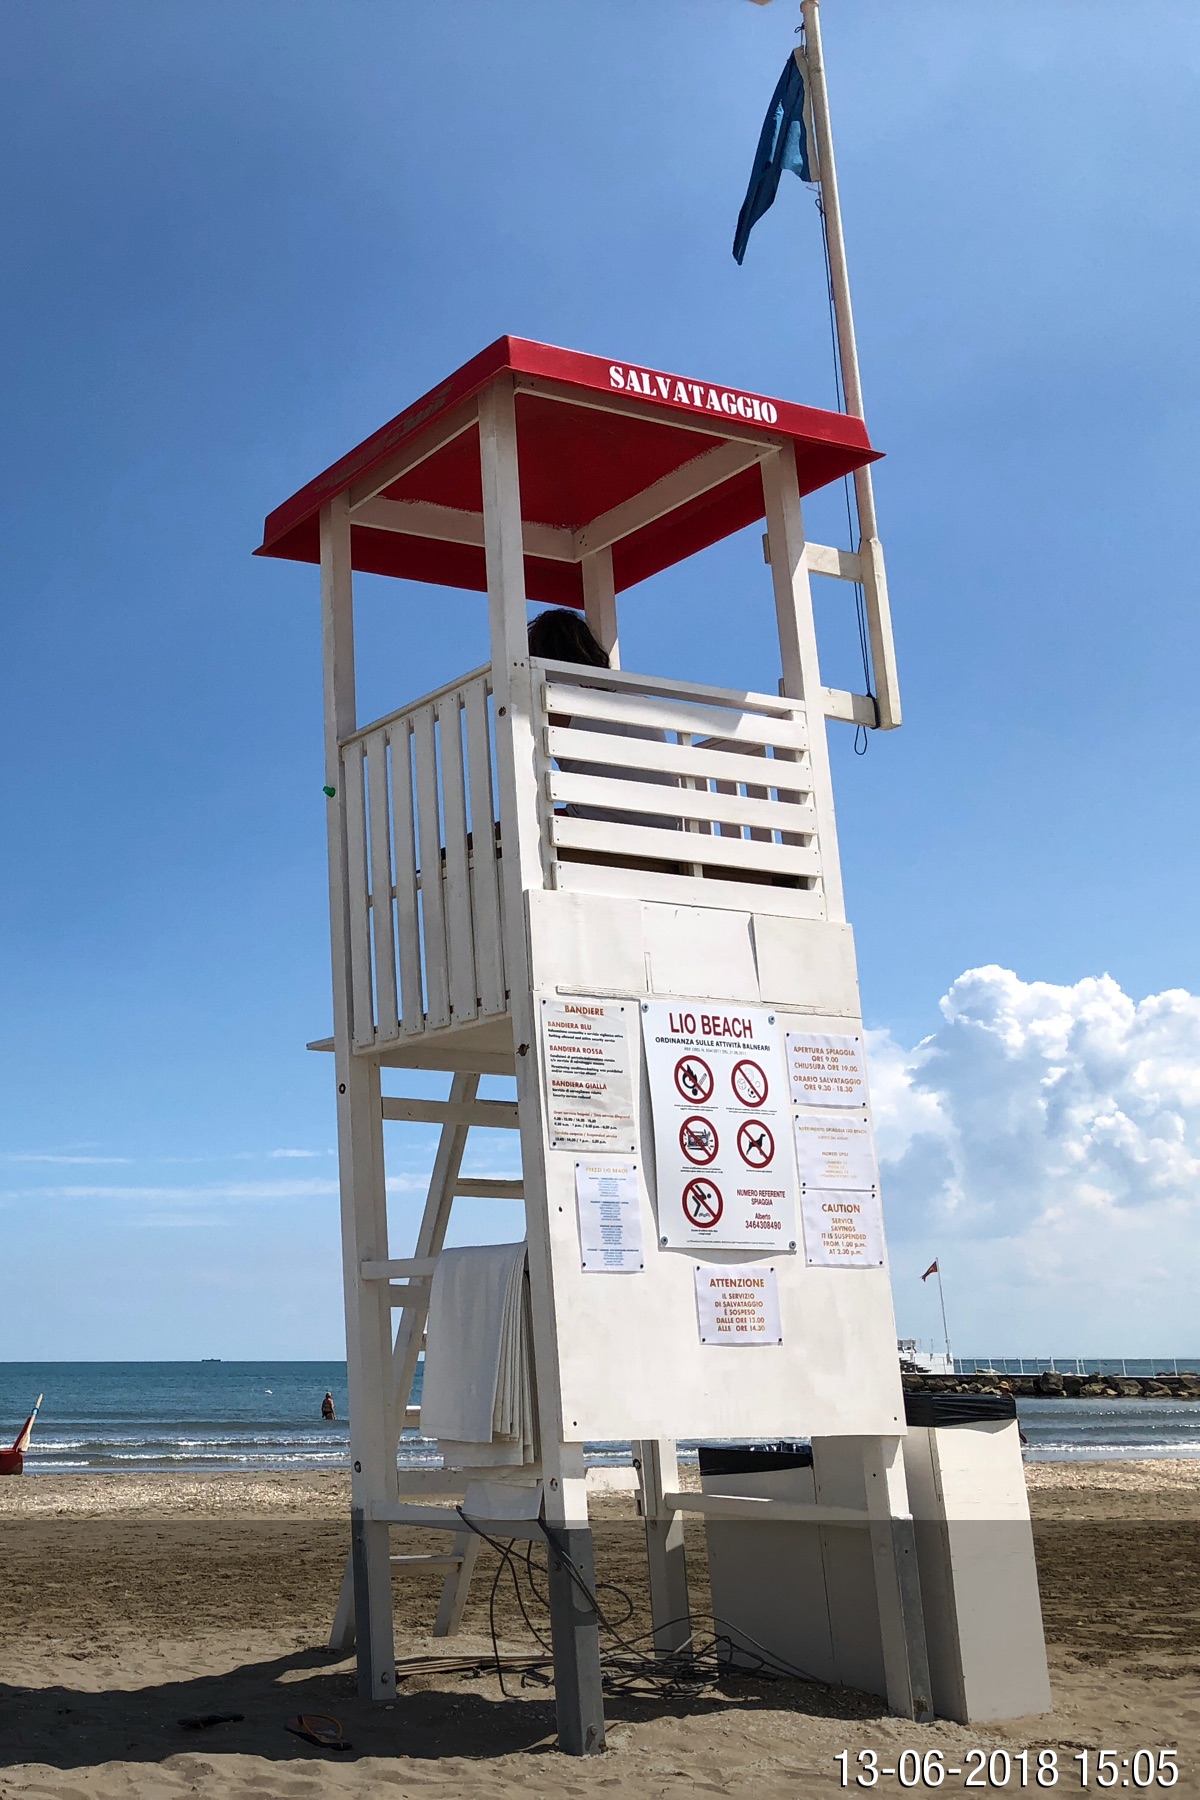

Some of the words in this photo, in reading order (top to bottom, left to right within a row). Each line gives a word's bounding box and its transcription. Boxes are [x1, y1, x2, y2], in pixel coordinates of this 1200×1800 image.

[609, 366, 777, 424] SALVATAGGIO
[565, 1005, 604, 1016] BANDIERE
[548, 1021, 578, 1029] BANDIERA
[669, 1013, 696, 1034] LIO
[701, 1015, 753, 1038] BEACH
[655, 1037, 694, 1045] ORDINANZA
[716, 1040, 740, 1048] ATTIVITÀ
[743, 1043, 770, 1051] BALNEARI
[550, 1045, 580, 1053] BANDIERA
[794, 1046, 824, 1054] APERTURA
[794, 1062, 825, 1070] CHIUSURA
[552, 1080, 583, 1088] BANDIERA
[820, 1077, 861, 1085] SALVATAGGIO
[759, 1190, 785, 1198] REFERENTE
[822, 1204, 860, 1213] CAUTION
[710, 1279, 764, 1287] ATTENZIONE
